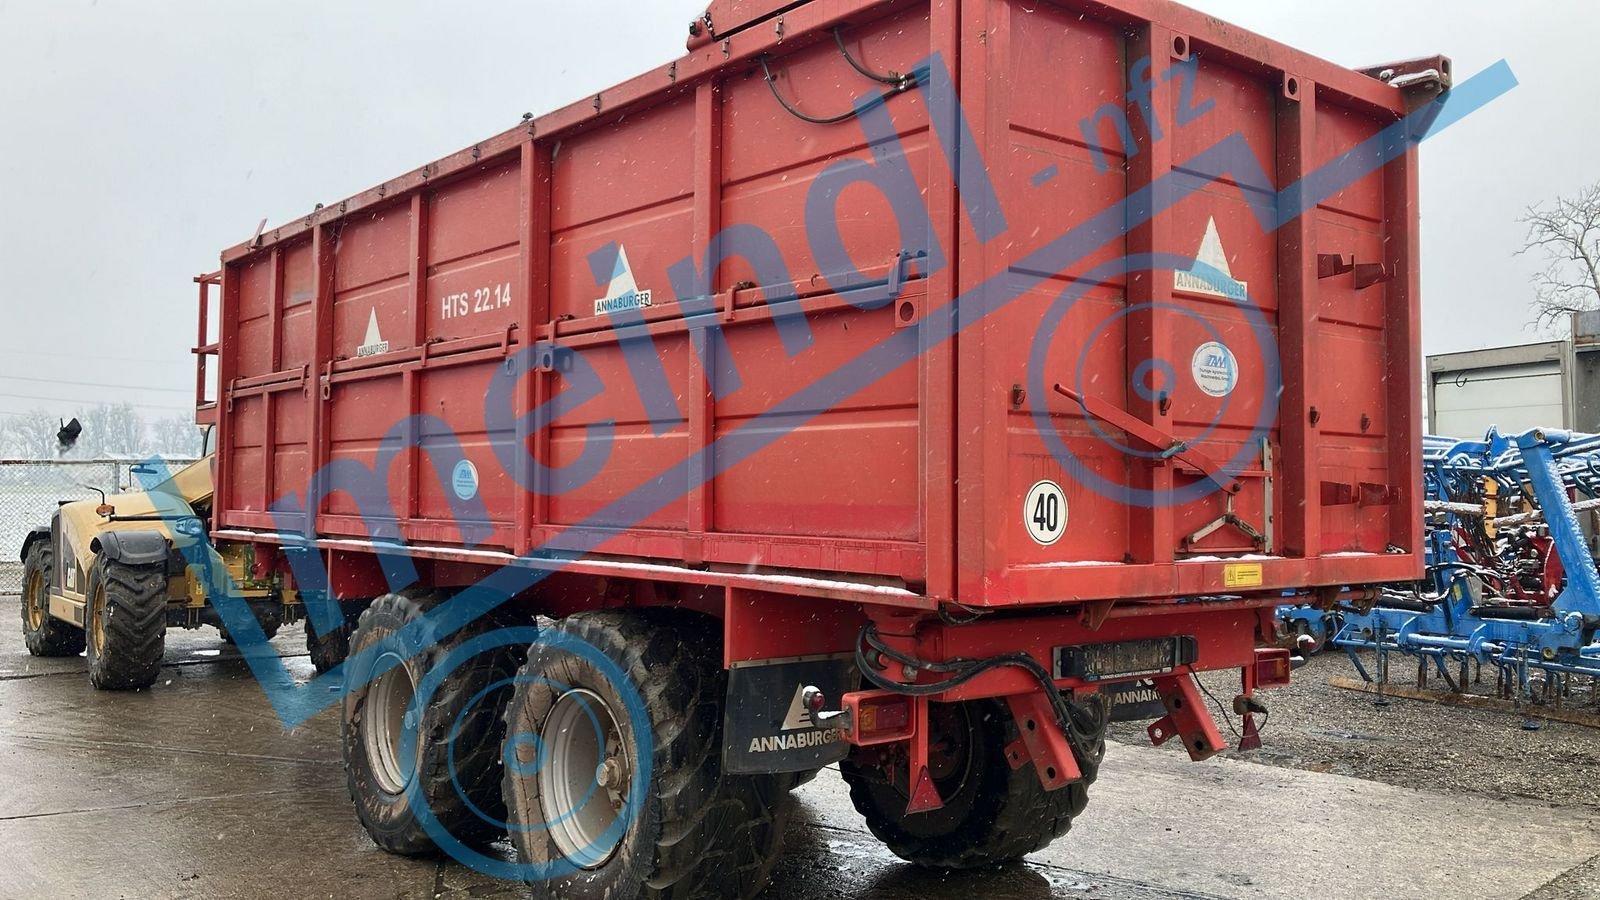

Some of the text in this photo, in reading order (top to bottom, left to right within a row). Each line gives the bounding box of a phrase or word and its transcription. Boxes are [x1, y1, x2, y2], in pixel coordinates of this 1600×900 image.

[442, 282, 511, 320] HTS 22.14
[1176, 272, 1246, 298] ANNABURGER
[596, 292, 650, 313] ANNABURGER
[1033, 493, 1058, 532] 40
